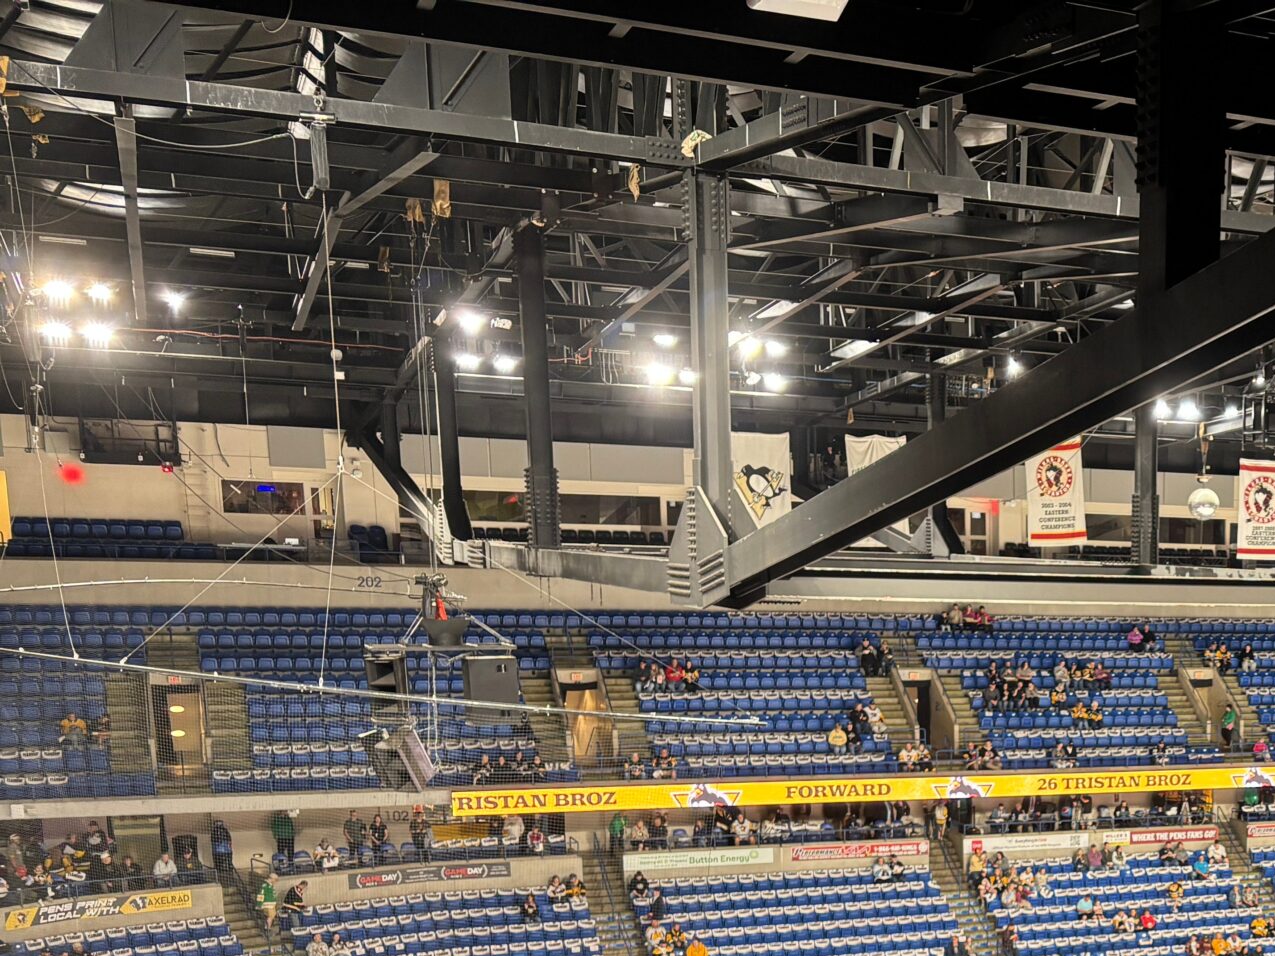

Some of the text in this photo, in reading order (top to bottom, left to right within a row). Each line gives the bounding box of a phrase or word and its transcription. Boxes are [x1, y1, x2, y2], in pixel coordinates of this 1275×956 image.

[357, 576, 382, 588] 202
[1037, 773, 1191, 791] 26 TRISTAN BROZ
[553, 791, 617, 807] BROZ
[785, 783, 892, 799] FORWARD
[1131, 830, 1217, 842] WHERE THE PENS FANS GO!
[689, 855, 719, 865] Button
[720, 854, 750, 864] Energy
[39, 897, 117, 916] PENS PRINT
[147, 894, 190, 907] AXELRAD
[39, 905, 120, 924] LOCAL WITH
